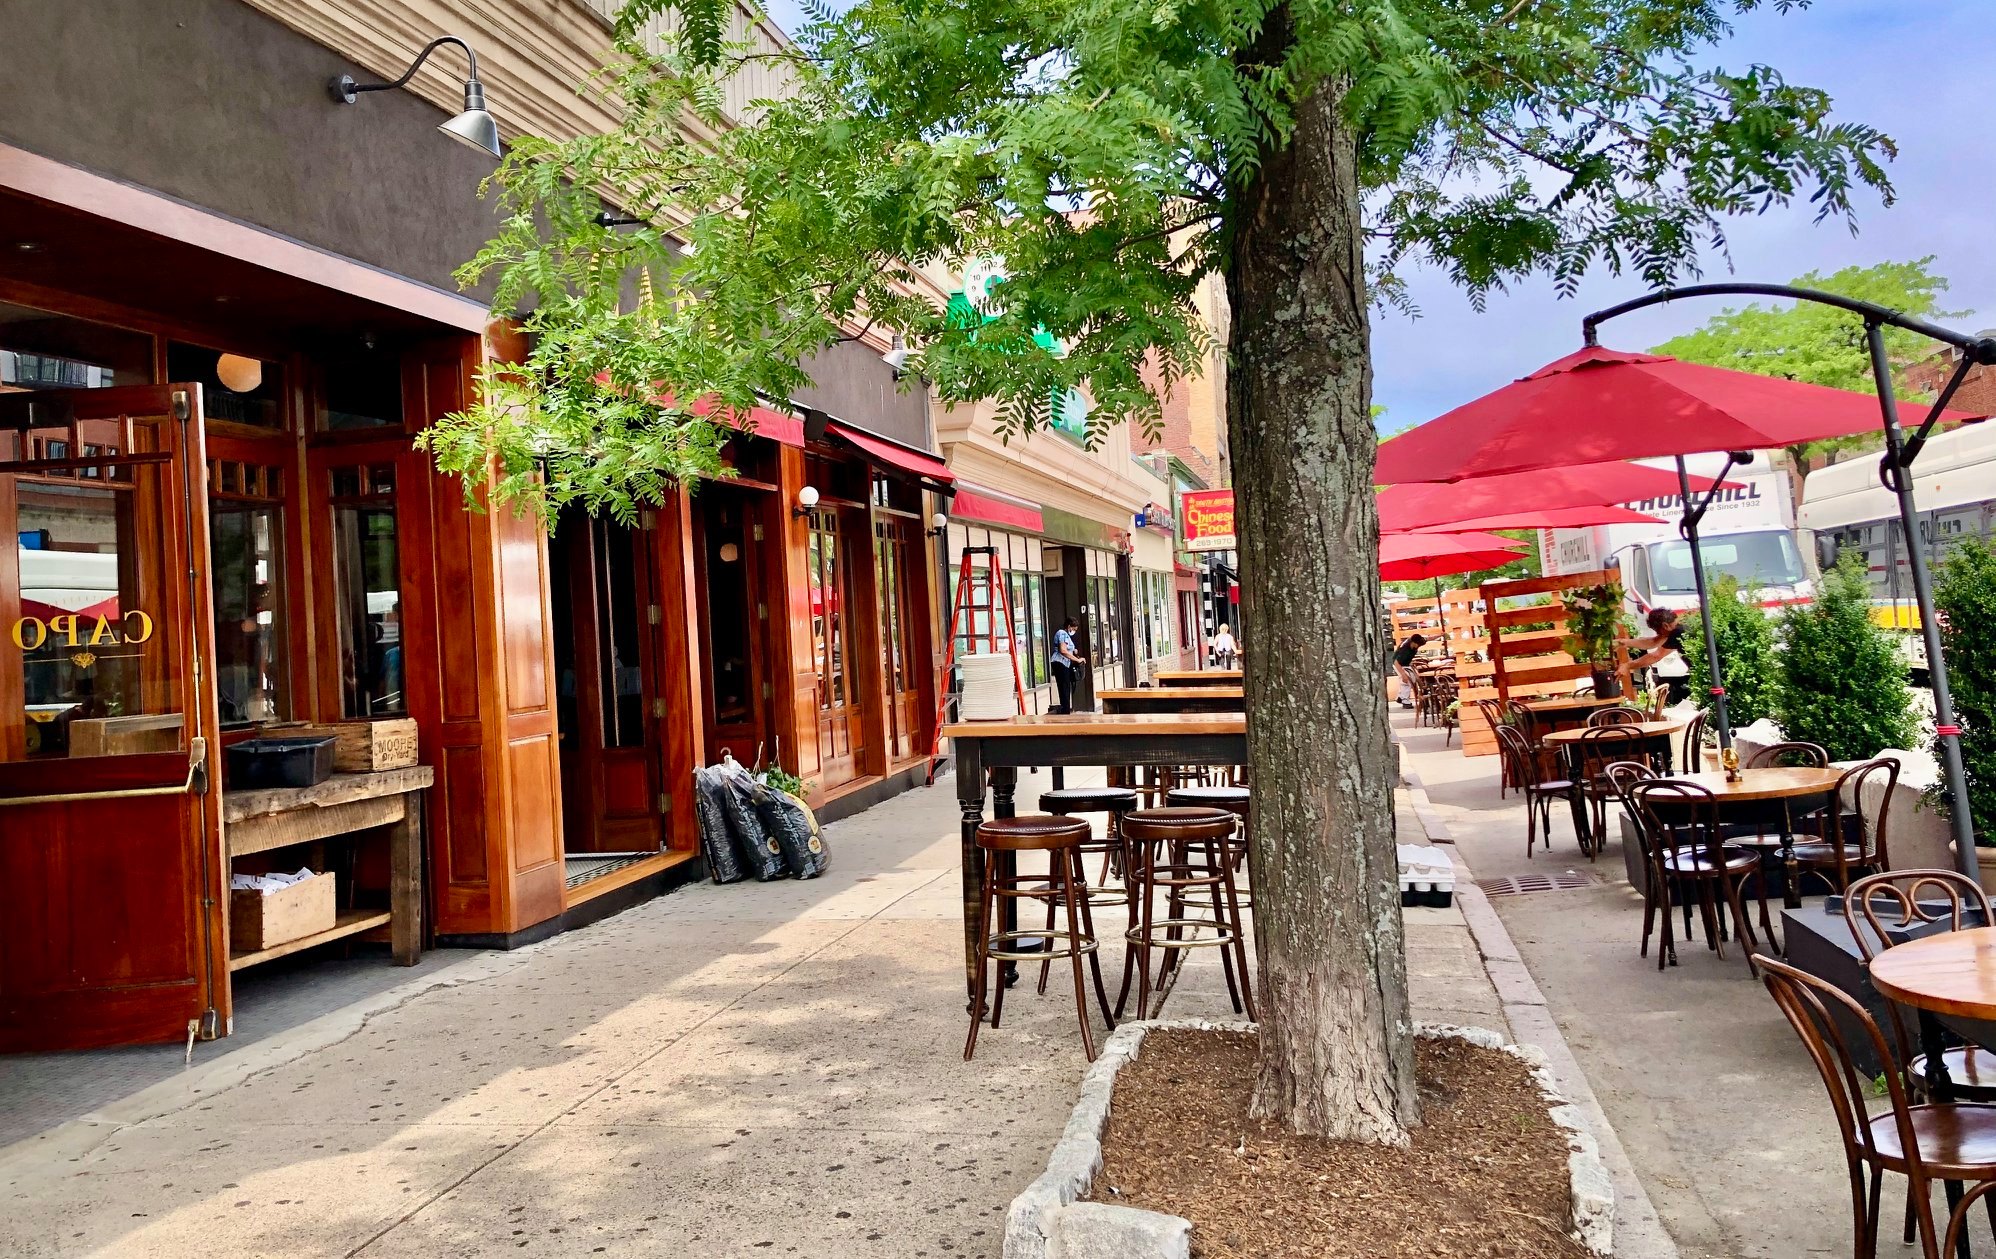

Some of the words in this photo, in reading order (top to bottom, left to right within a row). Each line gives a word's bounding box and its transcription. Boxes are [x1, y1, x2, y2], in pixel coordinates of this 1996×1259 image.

[1742, 500, 1760, 508] 1932
[1195, 521, 1232, 537] Food
[378, 737, 413, 753] MOORE
